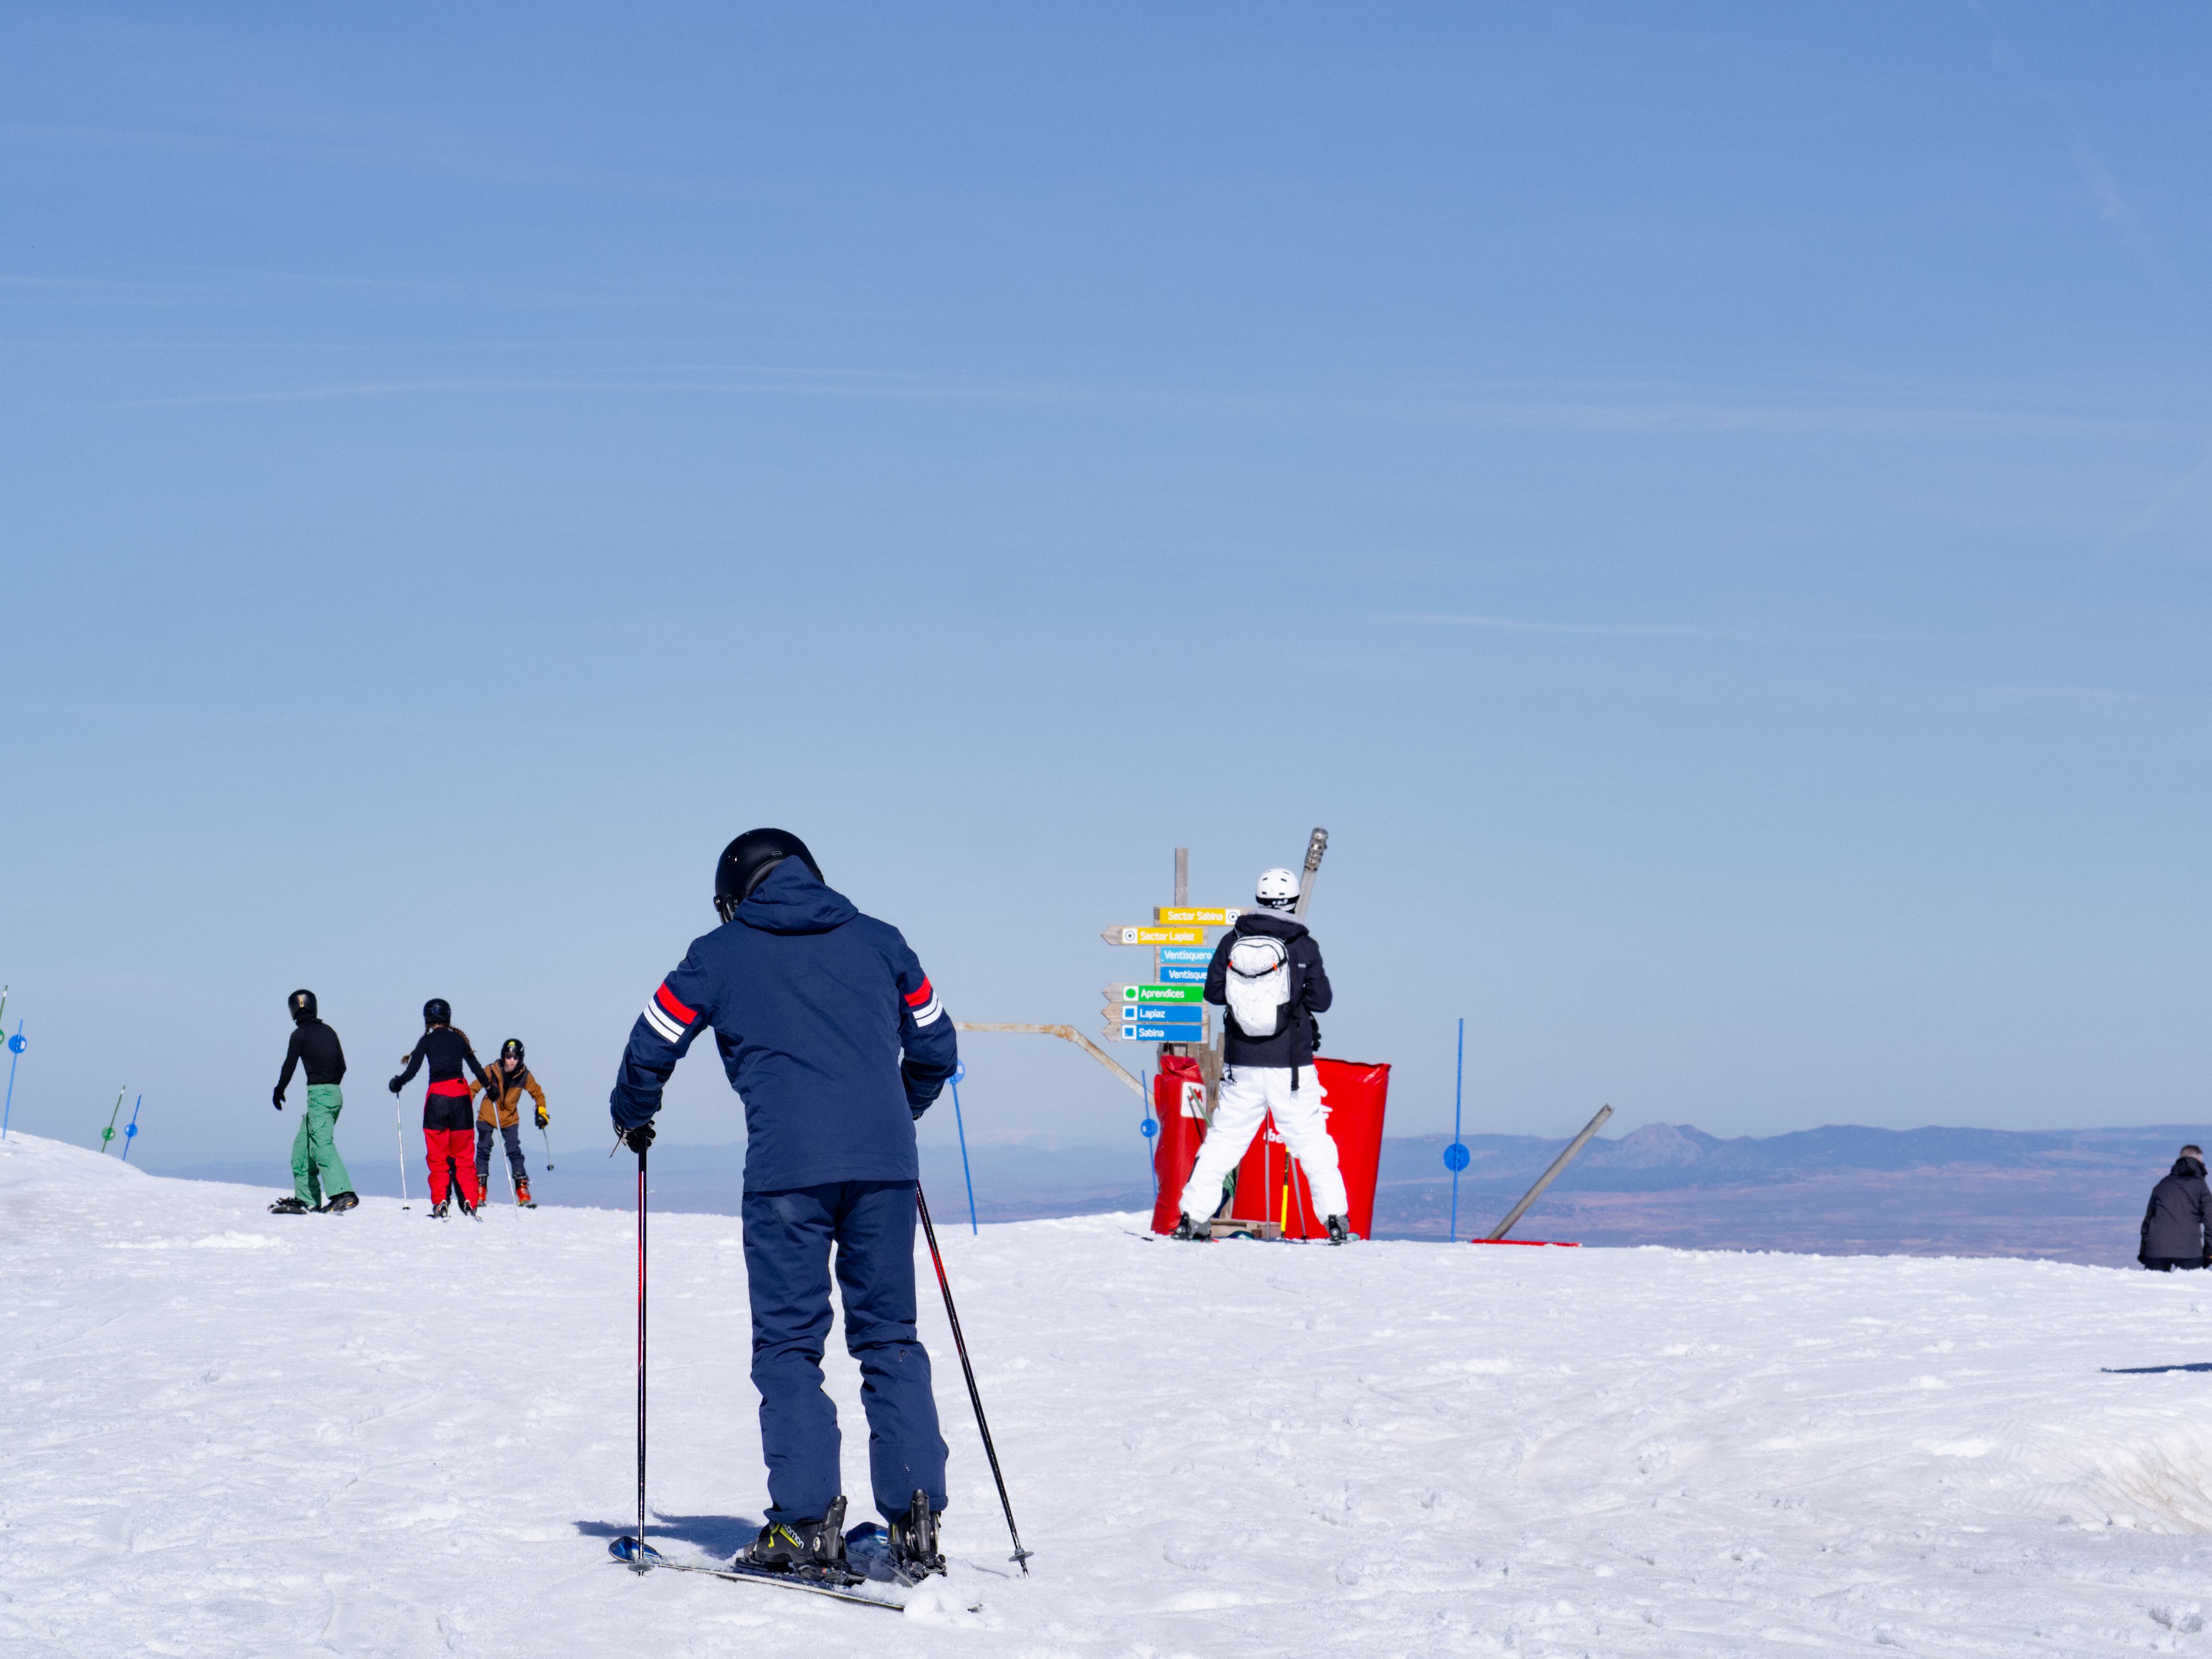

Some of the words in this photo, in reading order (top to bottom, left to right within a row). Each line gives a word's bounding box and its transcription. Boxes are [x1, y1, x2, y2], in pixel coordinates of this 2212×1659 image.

[1167, 911, 1195, 921] Sector
[1197, 911, 1224, 921] Sabina
[1140, 931, 1168, 941] Sector
[1169, 931, 1195, 942] Lapiaz
[1164, 950, 1212, 961] Ventisquero
[1141, 988, 1185, 999] Aprendices
[1140, 1009, 1166, 1020] Lapiaz
[1139, 1028, 1165, 1037] Sabina
[782, 1524, 804, 1549] lomon
